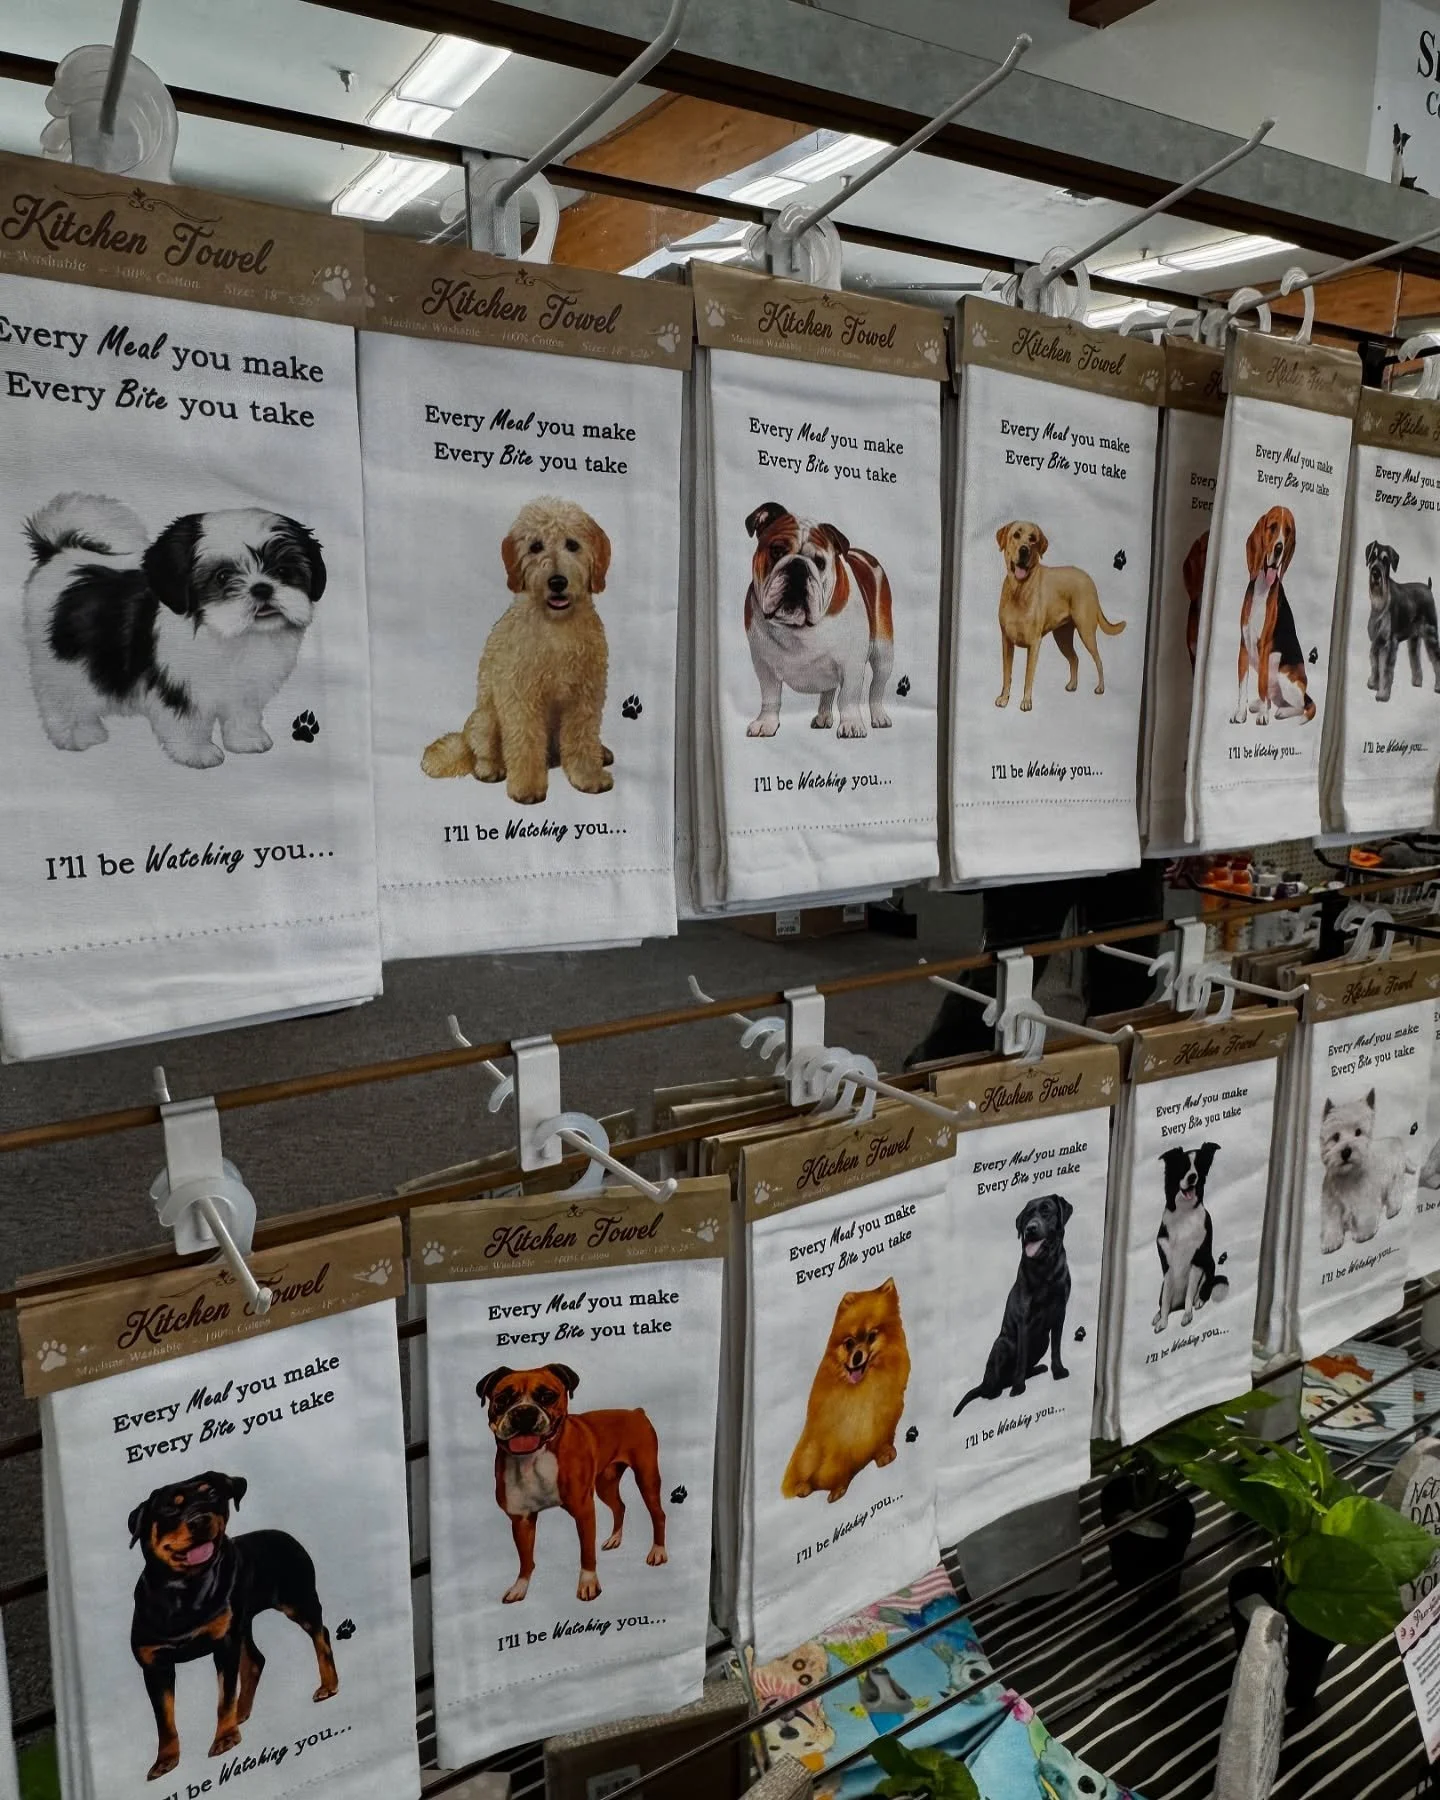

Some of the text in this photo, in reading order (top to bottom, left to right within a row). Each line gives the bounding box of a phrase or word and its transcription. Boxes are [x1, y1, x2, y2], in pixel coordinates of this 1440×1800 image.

[1426, 90, 1440, 118] C
[1, 194, 275, 275] Kitchen Towel
[156, 271, 201, 290] Cotton
[422, 278, 623, 334] Kitchen Towel
[758, 301, 897, 349] Kitchen Towel
[0, 315, 323, 383] Every Meal you make
[1012, 328, 1126, 375] Kitchen Towel
[4, 371, 314, 428] Every Bite you take
[425, 404, 636, 441] Every Meal you make
[749, 417, 903, 455] Every Meal you make
[1000, 419, 1130, 454] Every Meal you make
[434, 442, 627, 474] Every Bite you take
[757, 450, 897, 483] Every Bite you take
[1005, 449, 1126, 480] Every Bite you take
[1256, 444, 1333, 474] Every Meal you make
[1257, 469, 1329, 496] Every Bite you take
[1375, 465, 1402, 484] Every
[1420, 477, 1435, 488] you
[1192, 497, 1213, 510] Ever
[755, 770, 891, 793] I'll be Watching you...
[992, 760, 1103, 782] I'll be Watching you...
[444, 818, 626, 843] I'll be Watching you...
[45, 842, 333, 880] I'll be Watching you...
[1343, 969, 1417, 1005] Kitchen Towel
[1174, 1029, 1264, 1064] Kitchen Towel
[1328, 1042, 1353, 1057] Every
[1353, 1033, 1376, 1049] Meal
[1373, 1032, 1392, 1046] you
[1394, 1024, 1419, 1038] make
[1331, 1045, 1415, 1077] Every Bite you take
[979, 1073, 1083, 1113] Kitchen Towel
[1156, 1087, 1248, 1118] Every Meal you make
[1161, 1106, 1241, 1137] Every Bite you take
[797, 1149, 859, 1189] Kitchen
[866, 1127, 914, 1167] Towel
[973, 1141, 1087, 1173] Every Meal you make
[977, 1163, 1080, 1195] Every Bite you take
[484, 1212, 663, 1258] Kitchen Towel
[789, 1204, 916, 1262] Every Meal you make
[796, 1230, 912, 1285] Every Bite you take
[488, 1289, 679, 1321] Every Meal you make
[117, 1296, 230, 1350] Kitchen
[496, 1319, 672, 1346] Every Bite you take
[113, 1357, 339, 1433] Every Meal you make
[126, 1391, 334, 1464] Every Bite you take
[797, 1495, 903, 1564] I'll be Watching you...
[498, 1616, 666, 1651] I'll be Watching you...
[186, 1726, 351, 1800] be Watching you...
